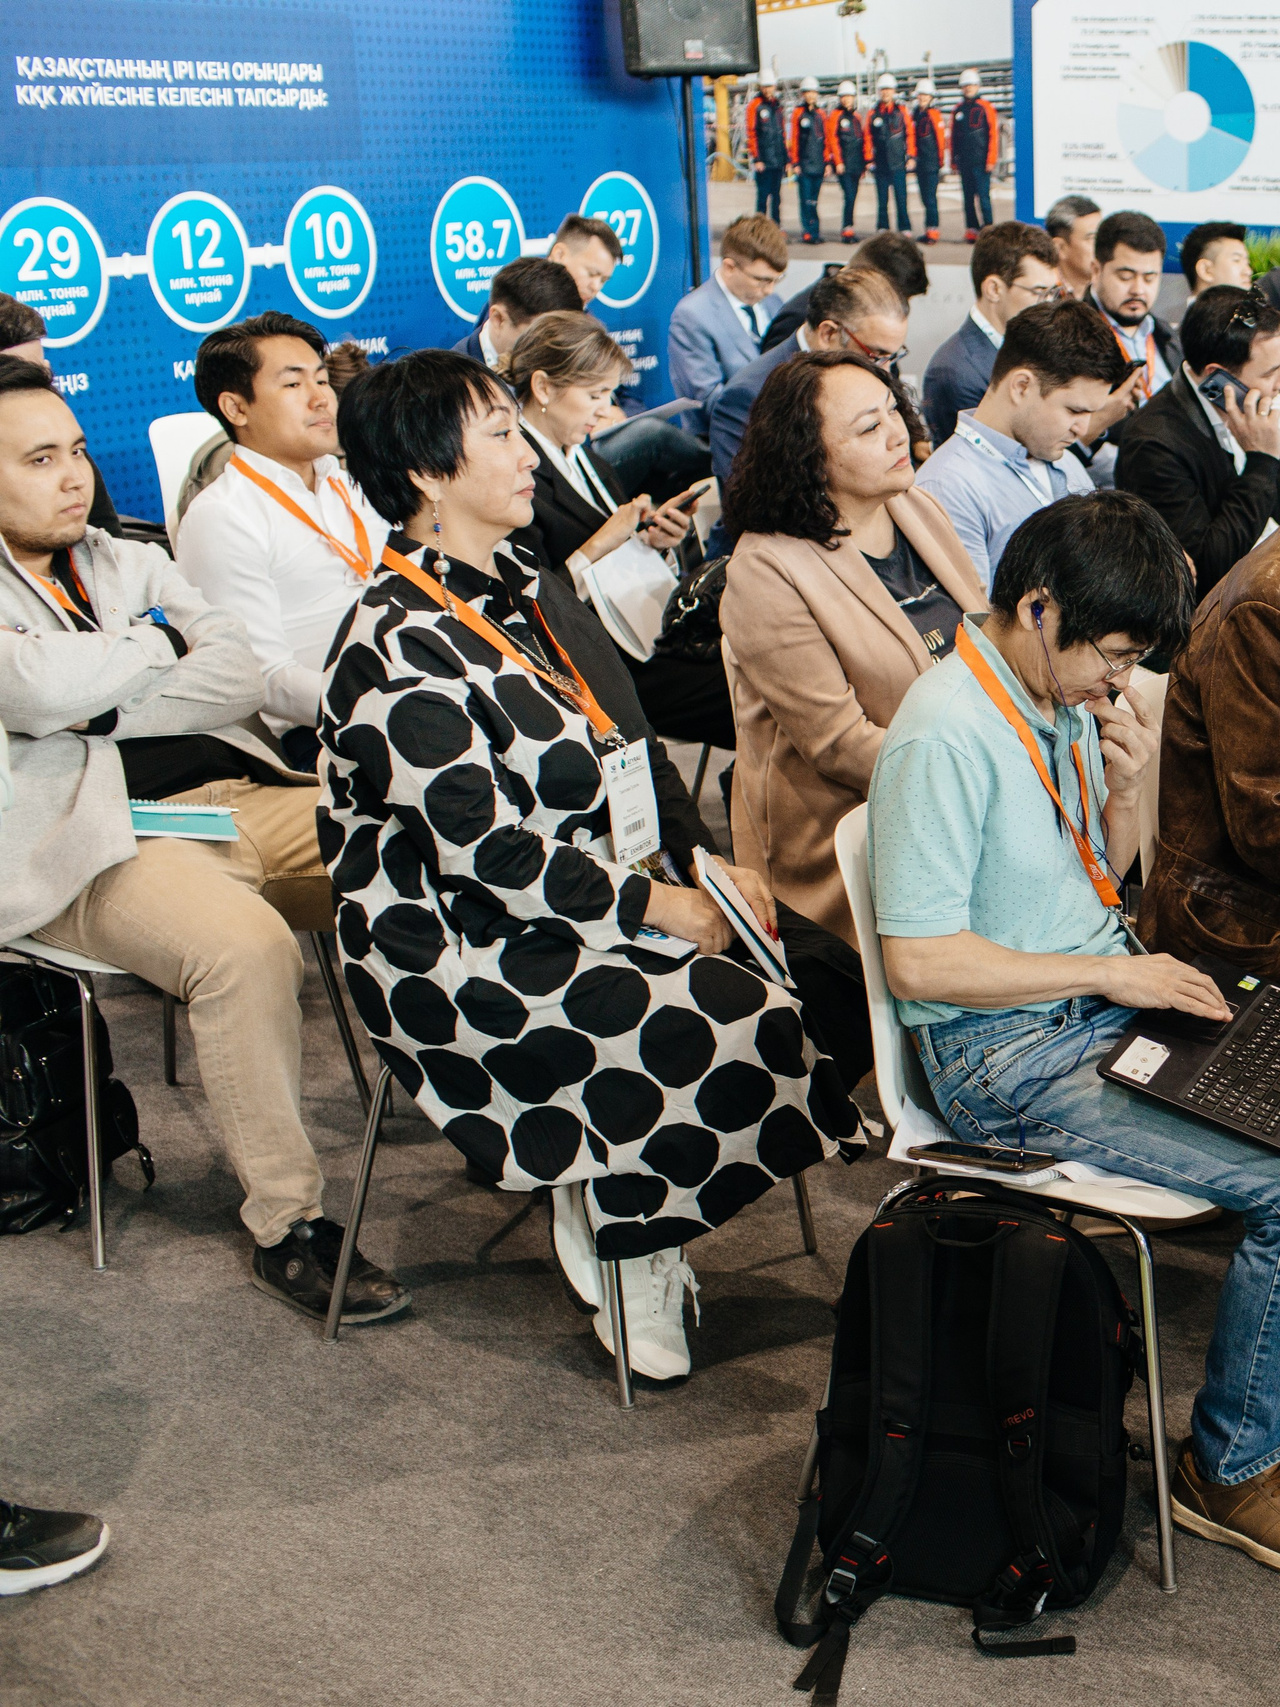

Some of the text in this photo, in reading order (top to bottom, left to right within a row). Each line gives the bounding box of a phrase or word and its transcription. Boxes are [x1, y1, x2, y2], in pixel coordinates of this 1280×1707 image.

[15, 56, 324, 84] ҚАЗАҚСТАННЫҢ ІРІ КЕН ОРЫНДАРЫ
[15, 82, 329, 110] КҚК ЖҮЙЕСІНЕ КЕЛЕСІНІ ТАПСЫРДЫ:
[171, 218, 225, 270] 12
[305, 211, 353, 260] 10
[445, 219, 512, 263] 58.7
[13, 226, 81, 281] 29
[304, 263, 361, 279] млн. тонна
[455, 267, 477, 280] млн.
[170, 274, 233, 290] млн. тонна
[317, 277, 350, 294] мұнай
[16, 286, 89, 303] млн. тонна
[184, 289, 222, 307] мұнай
[630, 839, 652, 857] EXHIBITOR
